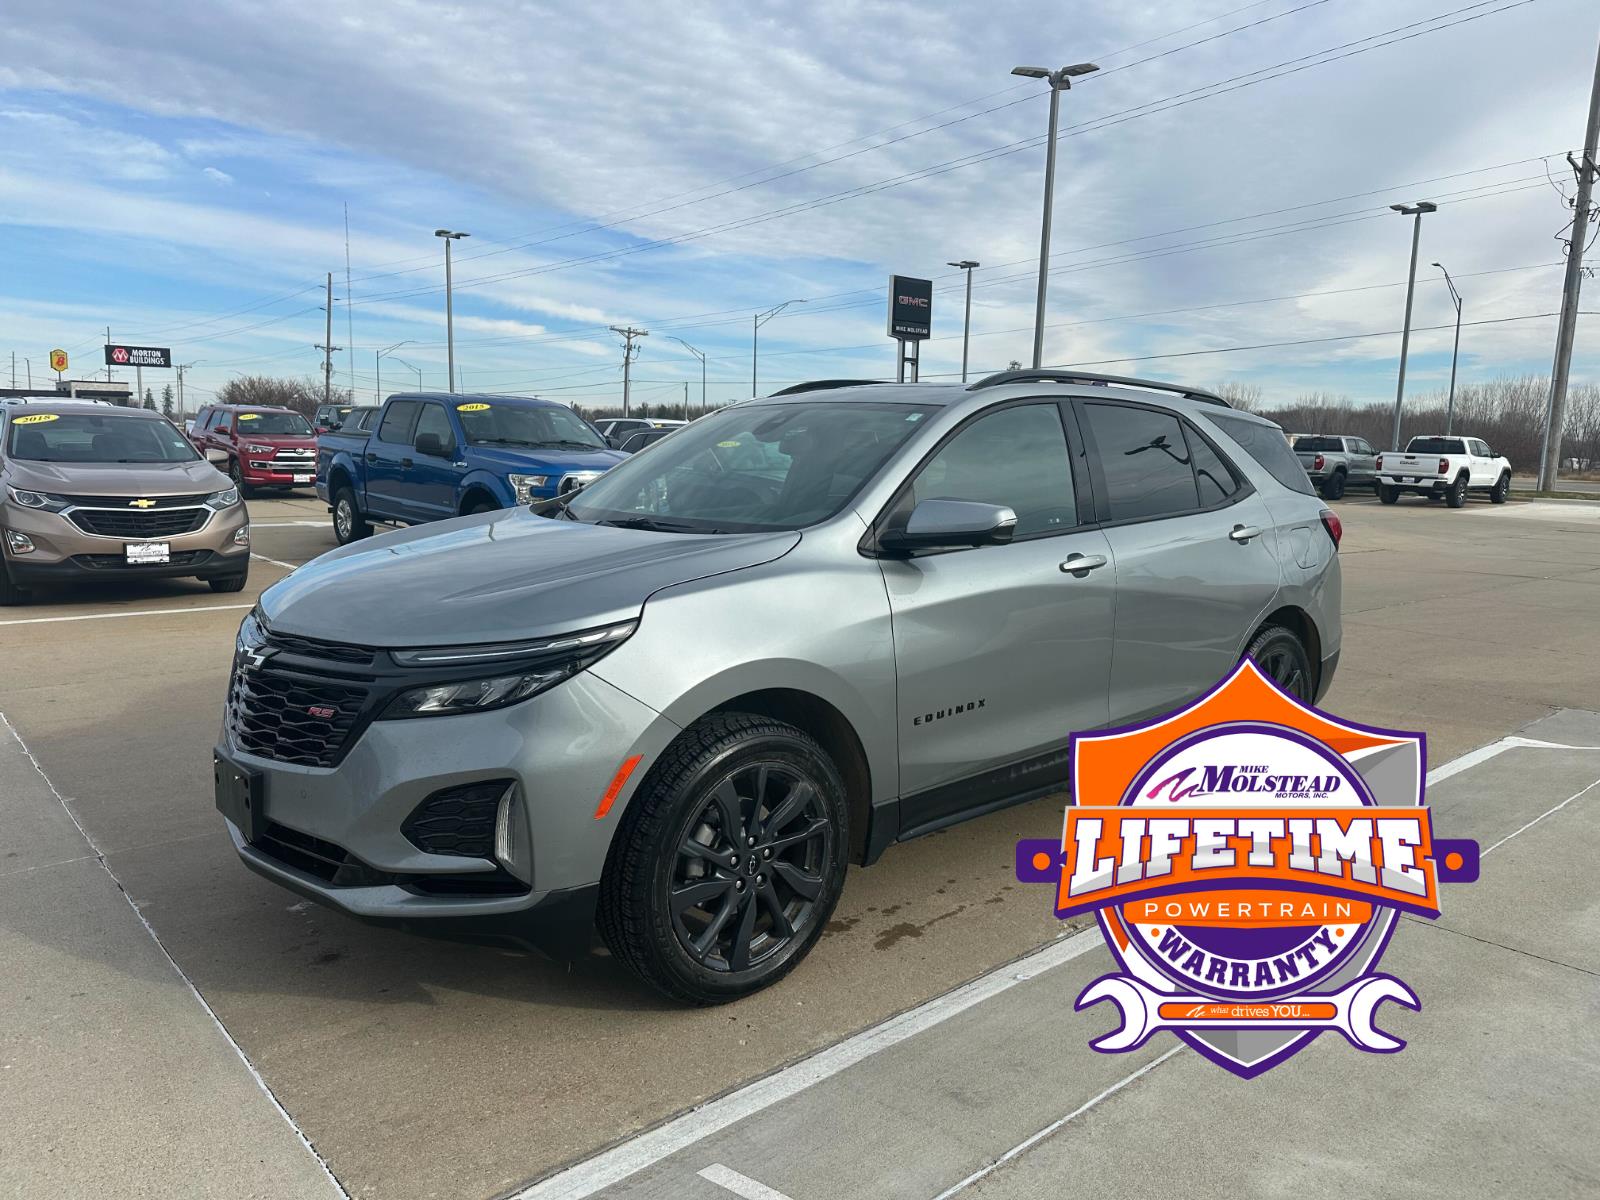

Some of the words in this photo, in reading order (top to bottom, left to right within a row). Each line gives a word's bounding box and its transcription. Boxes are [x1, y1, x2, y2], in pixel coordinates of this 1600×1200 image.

[898, 295, 929, 307] GMC
[131, 349, 161, 358] MORTON
[129, 356, 165, 365] BUILDINGS
[23, 415, 51, 423] 2018
[307, 706, 335, 718] RS
[913, 698, 986, 726] EQUINOX
